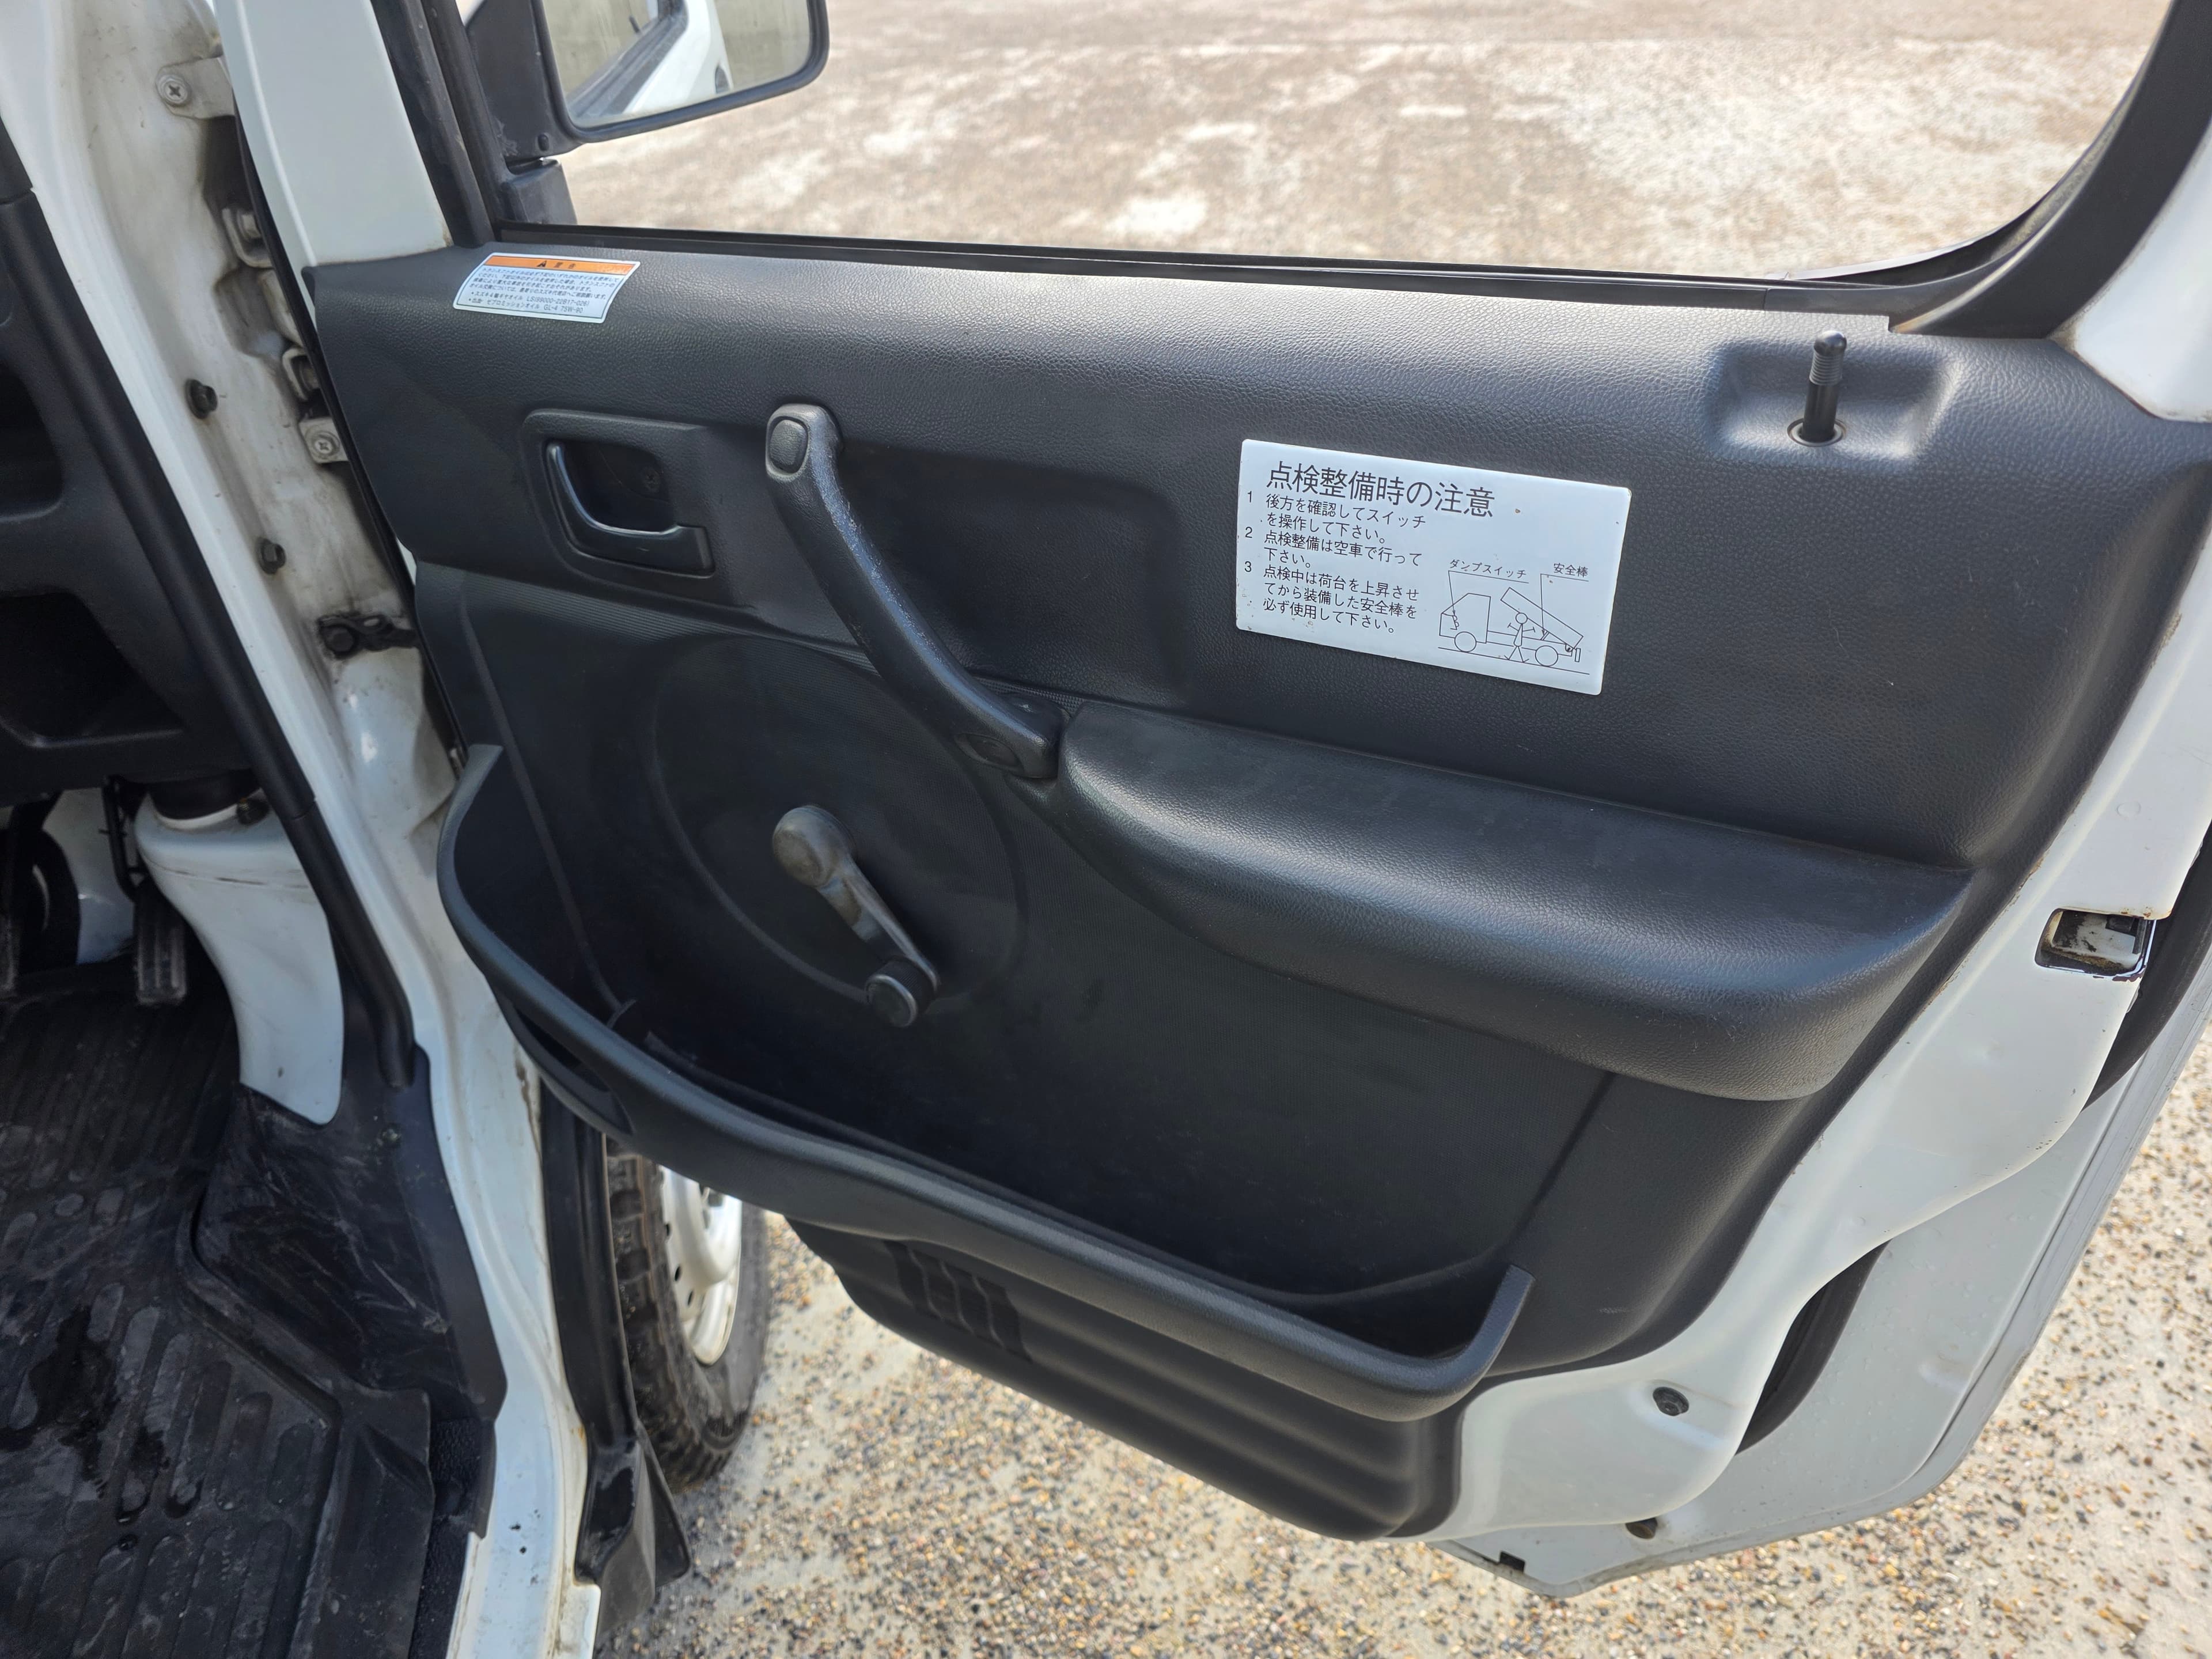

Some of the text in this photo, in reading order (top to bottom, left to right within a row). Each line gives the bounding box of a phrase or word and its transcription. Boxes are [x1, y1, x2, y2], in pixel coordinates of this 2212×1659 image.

[1266, 460, 1495, 518] 点検整備時の注意
[1247, 490, 1426, 529] 1 後方を確認してスイッチ
[1267, 512, 1385, 544] を操作して下さい。
[1244, 527, 1422, 566] 2 点検整備は空車で行って
[1264, 547, 1311, 569] 下さい。
[1244, 561, 1419, 601] 3 点検中は荷台を上昇させ
[1449, 559, 1527, 579] ダンプスイッチ
[1553, 562, 1589, 578] 安全棒
[1263, 598, 1395, 634] 必ず使用して下さい。
[1264, 582, 1417, 619] てから装備した安全棒を
